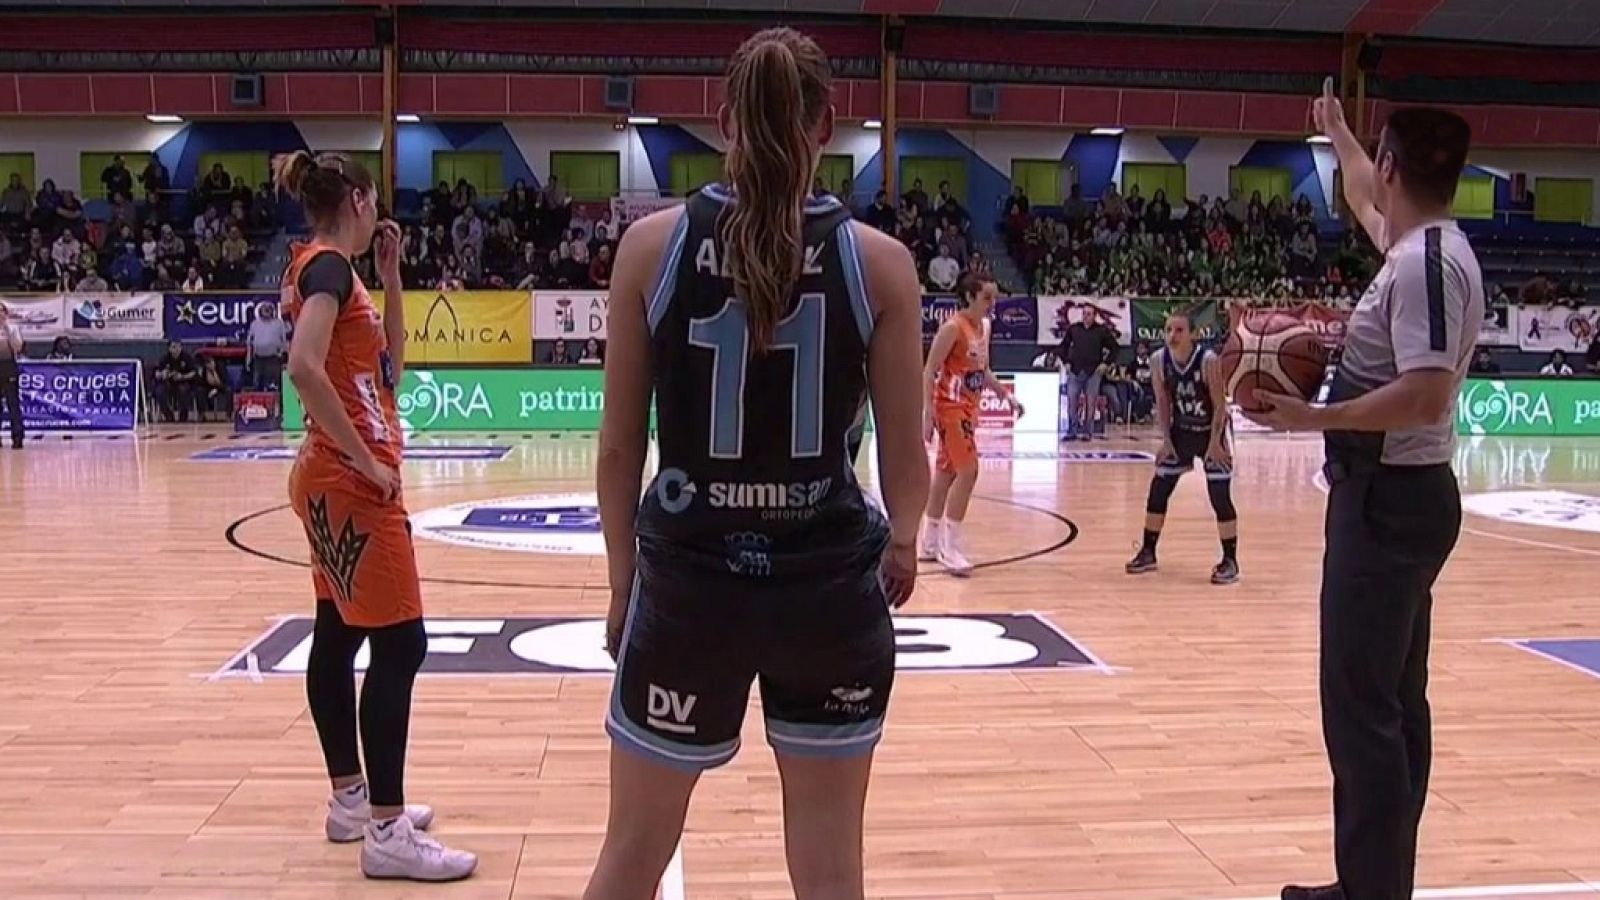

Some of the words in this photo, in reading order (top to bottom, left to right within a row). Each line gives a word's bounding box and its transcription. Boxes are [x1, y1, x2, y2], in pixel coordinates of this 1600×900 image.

[107, 305, 156, 319] Gumer
[53, 372, 130, 390] cruces
[688, 293, 826, 458] 11
[708, 477, 832, 509] sumisan
[647, 683, 697, 723] DV
